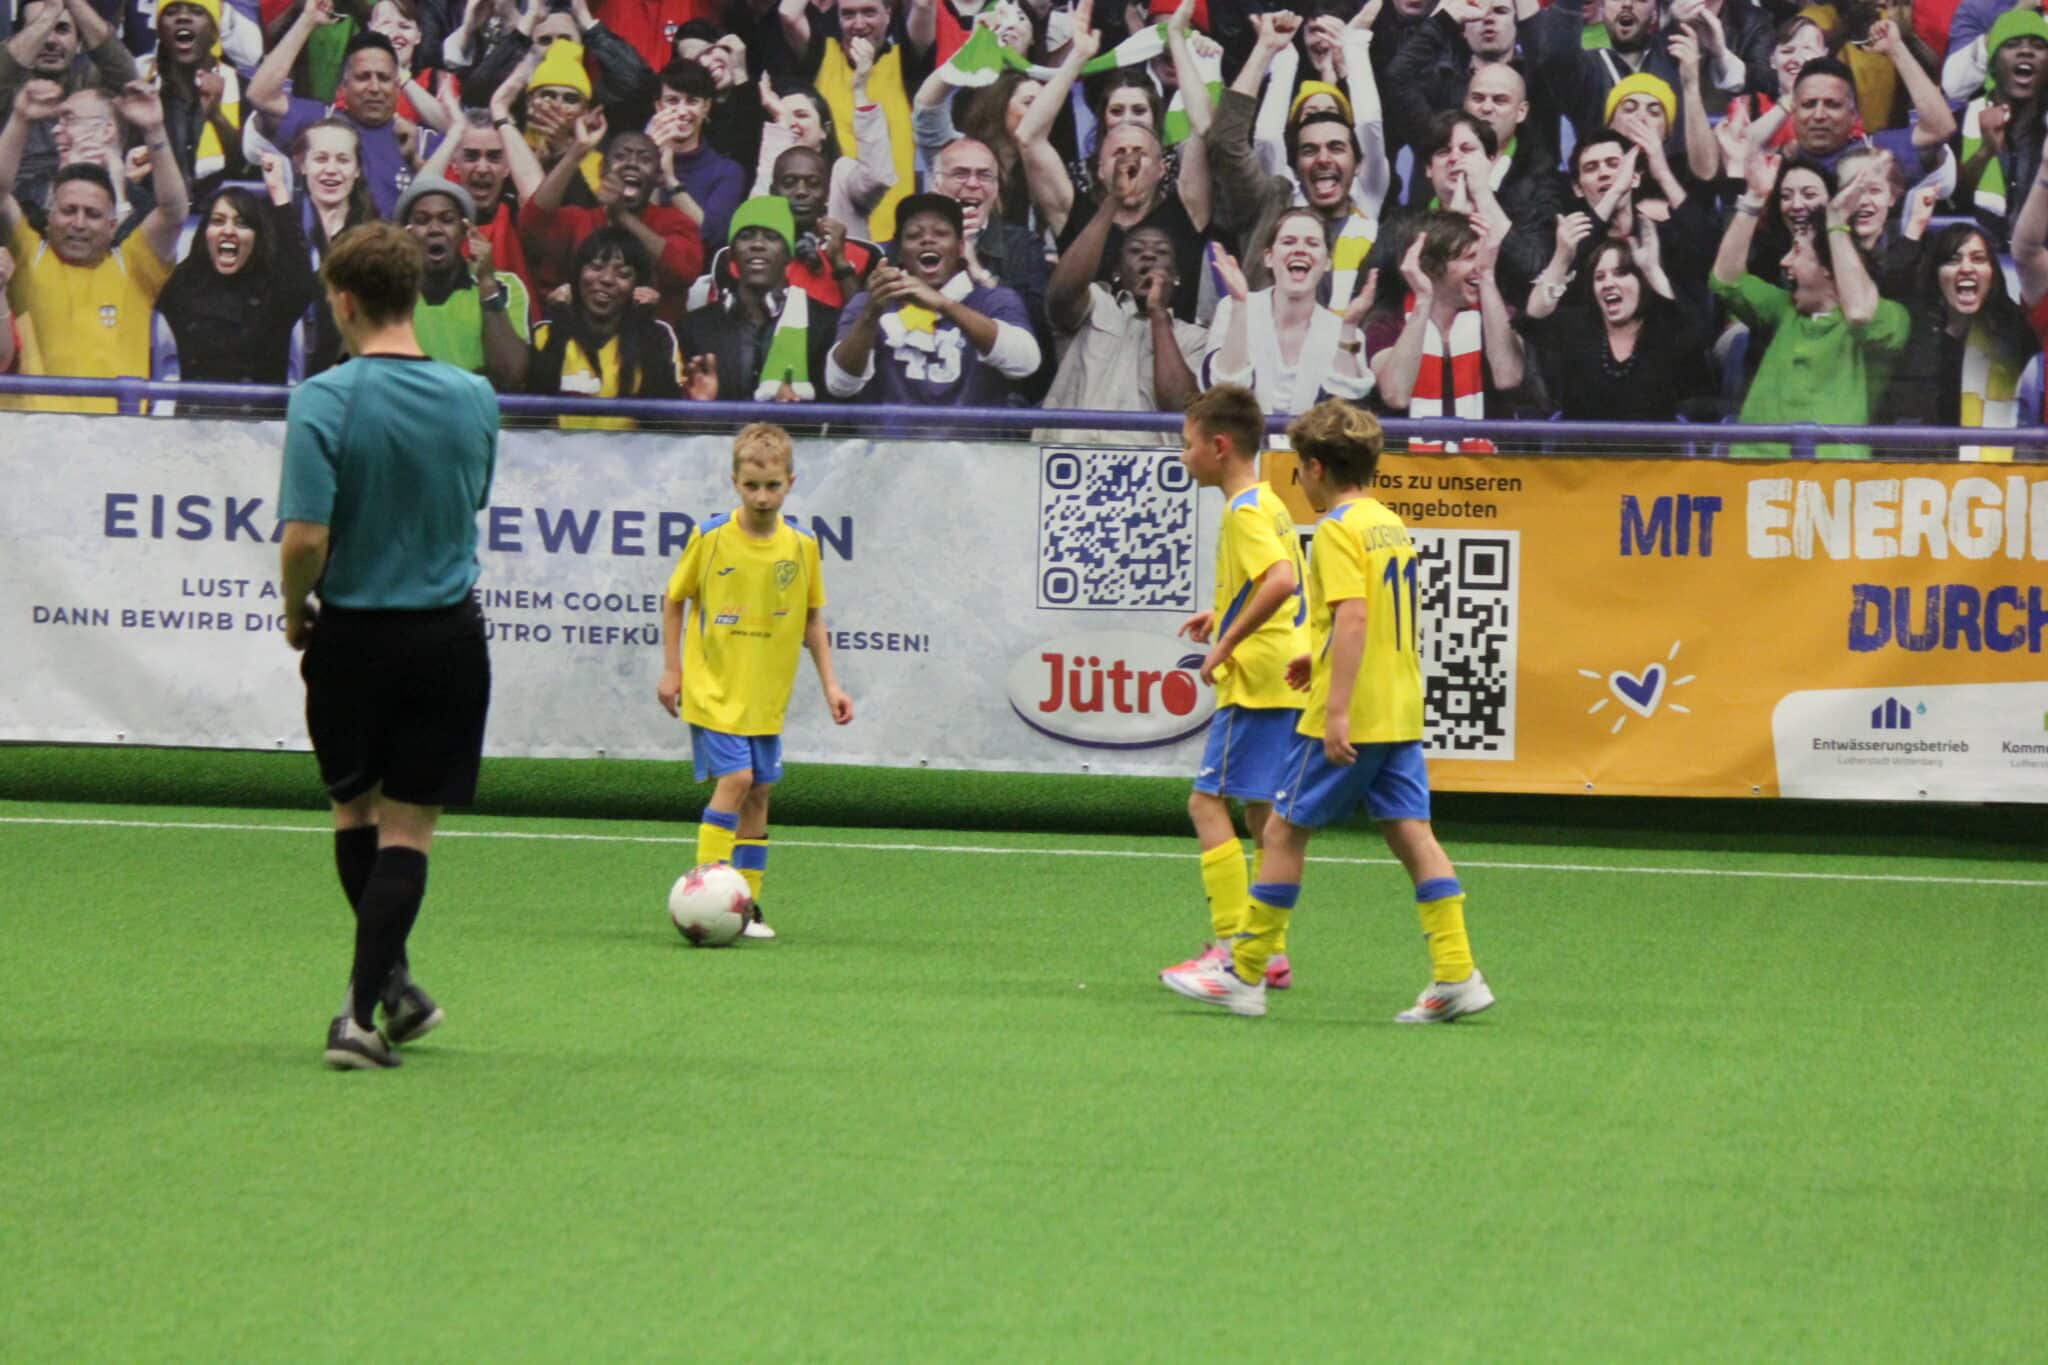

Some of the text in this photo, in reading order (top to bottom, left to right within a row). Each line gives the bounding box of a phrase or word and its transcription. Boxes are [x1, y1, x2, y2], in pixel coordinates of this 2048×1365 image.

[1408, 474, 1432, 490] zu
[1438, 475, 1522, 492] unseren
[104, 493, 853, 561] EISK EWERN
[1380, 498, 1497, 521] angeboten
[1619, 494, 1722, 557] MIT
[182, 578, 250, 598] LUST
[259, 580, 287, 599] A
[564, 592, 665, 613] COOLE
[1383, 556, 1416, 651] 11
[33, 605, 109, 627] DANN
[121, 608, 233, 631] BEWIRB
[245, 612, 287, 632] DIC
[484, 617, 551, 643] ÜTRO
[562, 622, 660, 646] TIEFKÜ
[1039, 653, 1198, 717] Jütro
[1812, 737, 1969, 754] Entwässerungsbetrieb
[2002, 740, 2048, 753] Komm
